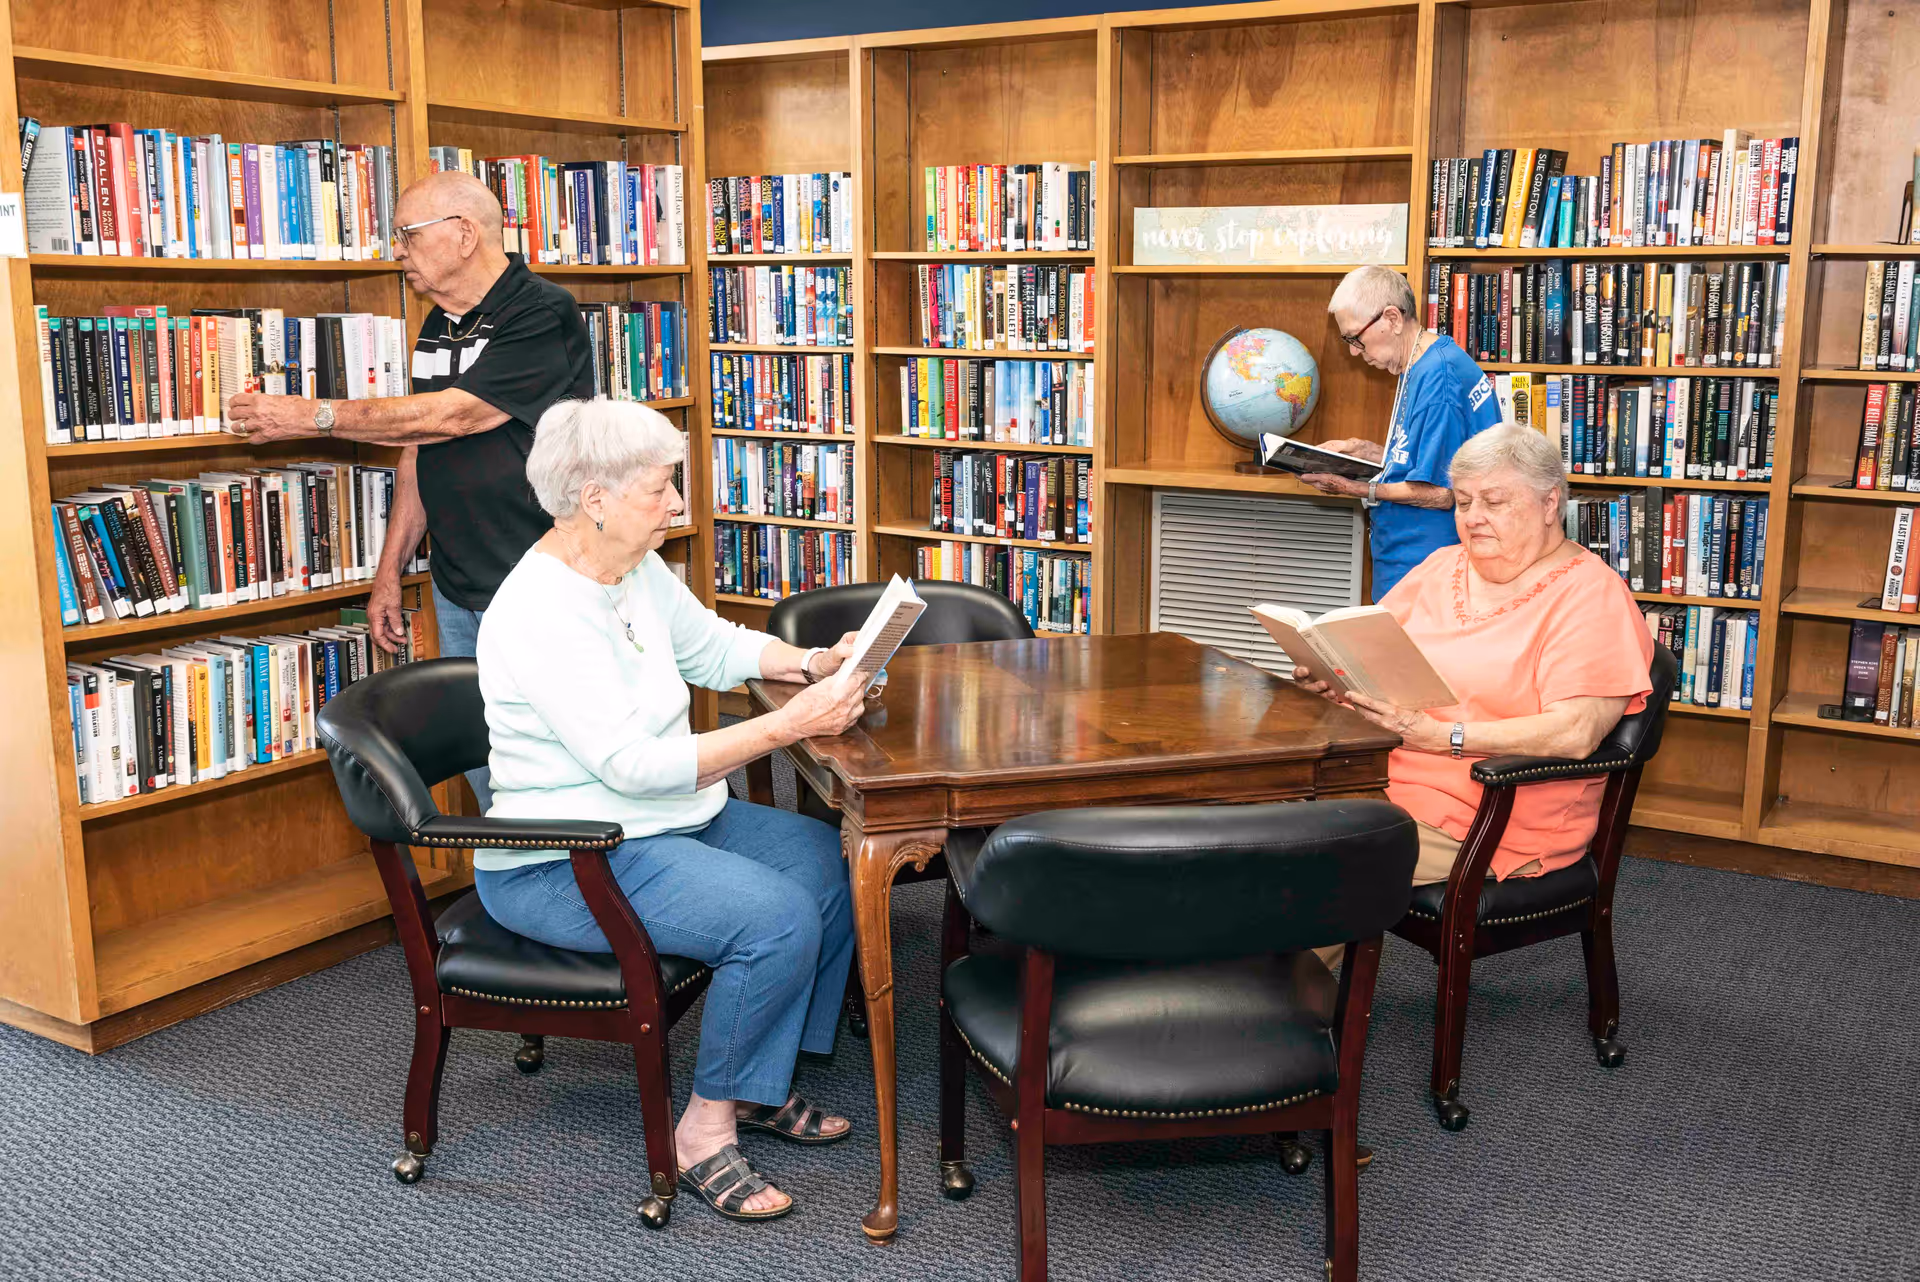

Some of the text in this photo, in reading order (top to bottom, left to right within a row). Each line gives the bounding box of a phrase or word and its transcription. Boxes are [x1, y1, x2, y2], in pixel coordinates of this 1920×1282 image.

[1763, 142, 1773, 170] Griffin
[98, 150, 109, 206] FALLEN
[231, 158, 244, 207] most wanted
[1498, 167, 1507, 196] GRAFTON
[1528, 153, 1547, 218] SUE GRAFTON
[1496, 196, 1505, 205] T
[1142, 213, 1394, 258] never stop exploring
[1887, 267, 1898, 279] THE
[1438, 265, 1450, 324] Martha Grimes
[1708, 276, 1720, 318] JOHN GRISHAM
[1884, 280, 1896, 302] SEARCH
[1502, 320, 1508, 330] TO
[1585, 295, 1596, 324] GRISHAM
[1601, 306, 1613, 352] JOHN GRISHAM
[945, 363, 956, 401] DICK FRANCIS
[1561, 378, 1571, 448] QUILLER BAMBOO ADAM
[1653, 391, 1663, 438] Sole Survivor
[1864, 390, 1882, 446] FAYE KELLERMAN
[1902, 400, 1910, 422] Sanctuary
[943, 478, 952, 503] GRAND
[1077, 462, 1087, 499] JULIE GARWOOD
[104, 505, 119, 539] MITCHARD
[107, 503, 123, 537] JACQUELYN
[145, 505, 155, 526] MILLER
[68, 518, 82, 552] THE CELL
[1702, 532, 1710, 547] Eagle
[1742, 505, 1756, 562] JACK HIGGINS
[1894, 512, 1910, 563] THE LAST TEMPLAR
[120, 543, 142, 599] The Breakdown Lane
[165, 570, 175, 592] FOREST
[1887, 578, 1896, 598] KHOURY
[413, 624, 423, 651] SAIL
[1687, 629, 1696, 650] RIVERS
